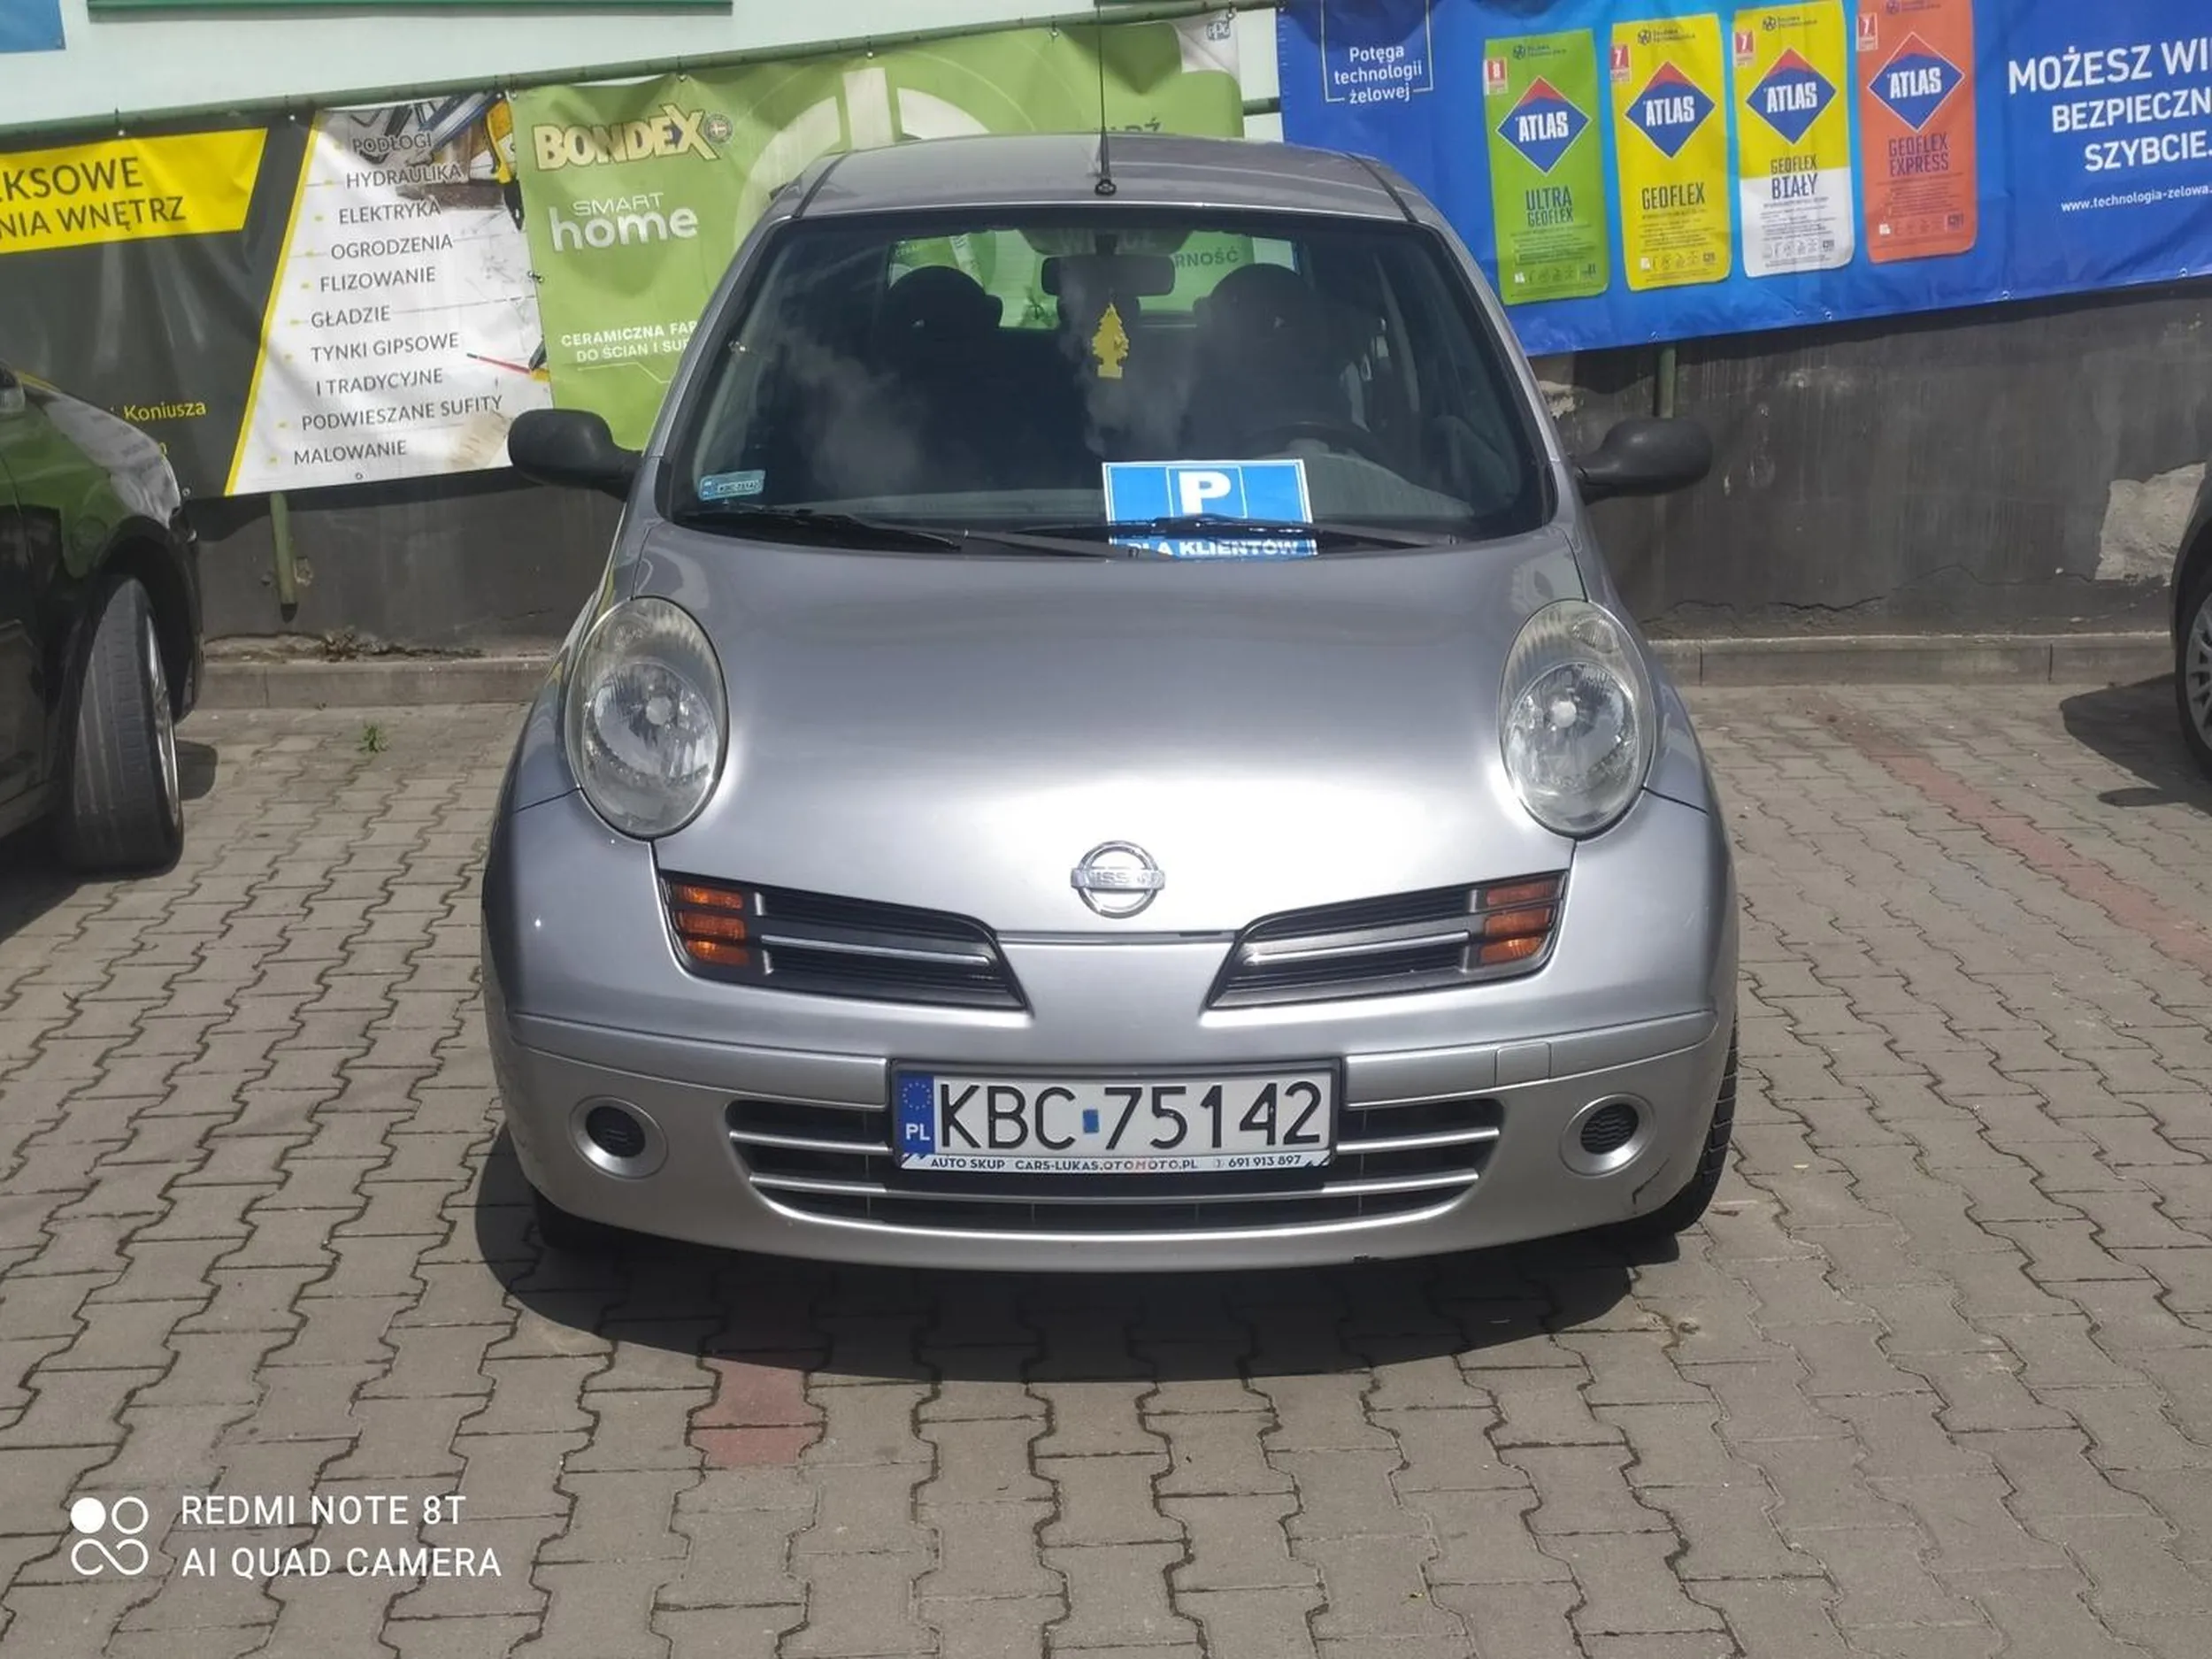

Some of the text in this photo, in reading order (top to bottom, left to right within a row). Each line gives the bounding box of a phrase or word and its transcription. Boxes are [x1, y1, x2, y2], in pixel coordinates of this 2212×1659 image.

[1349, 46, 1405, 63] Potęga
[2008, 37, 2212, 95] MOŻESZ WI
[1334, 60, 1423, 85] technologii
[1890, 66, 1941, 99] ATLAS
[1349, 82, 1410, 104] żelowej
[1766, 81, 1818, 113] ATLAS
[1646, 96, 1695, 127] ATLAS
[2052, 87, 2211, 133] BEZPIECZN
[533, 103, 720, 171] BONDEX
[1518, 111, 1569, 142] ATLAS
[352, 132, 432, 152] PODŁOGI
[1888, 133, 1948, 157] GEOFLEX
[2085, 130, 2212, 173] SZYBCIE.
[346, 164, 463, 188] HYDRAULIKA
[1770, 154, 1817, 174] GEOFLEX
[1889, 152, 1949, 177] EXPRESS
[0, 157, 142, 202] KSOWE
[1771, 173, 1817, 199] BIAŁY
[572, 192, 664, 216] SMART
[1526, 185, 1572, 211] ULTRA
[1641, 182, 1706, 210] GEOFLEX
[56, 196, 187, 233] WNĘTRZ
[339, 200, 442, 225] ELEKTRYKA
[1528, 207, 1573, 227] GEOFLEX
[549, 207, 699, 251] home
[331, 234, 453, 260] OGRODZENIA
[320, 266, 436, 292] FLIZOWANIE
[311, 305, 391, 328] GŁADZIE
[311, 332, 459, 363] TYNKI GIPSOWE
[561, 325, 664, 347] CERAMICZNA
[576, 349, 598, 363] DO
[603, 343, 648, 359] ŚCIAN
[653, 342, 658, 353] I
[316, 367, 443, 396] I TRADYCYJNE
[124, 402, 206, 422] Koniusza
[302, 395, 503, 431] PODWIESZANE SUFITY
[294, 440, 407, 465] MALOWANIE
[1179, 471, 1232, 515] P
[1179, 539, 1298, 556] KLIENTÓW
[941, 1080, 1322, 1150] KBC 75142
[905, 1123, 930, 1141] PL
[931, 1155, 1302, 1171] AUTO SKUP CARS-LUKAS.OTOMOTO.PL 691 913 897
